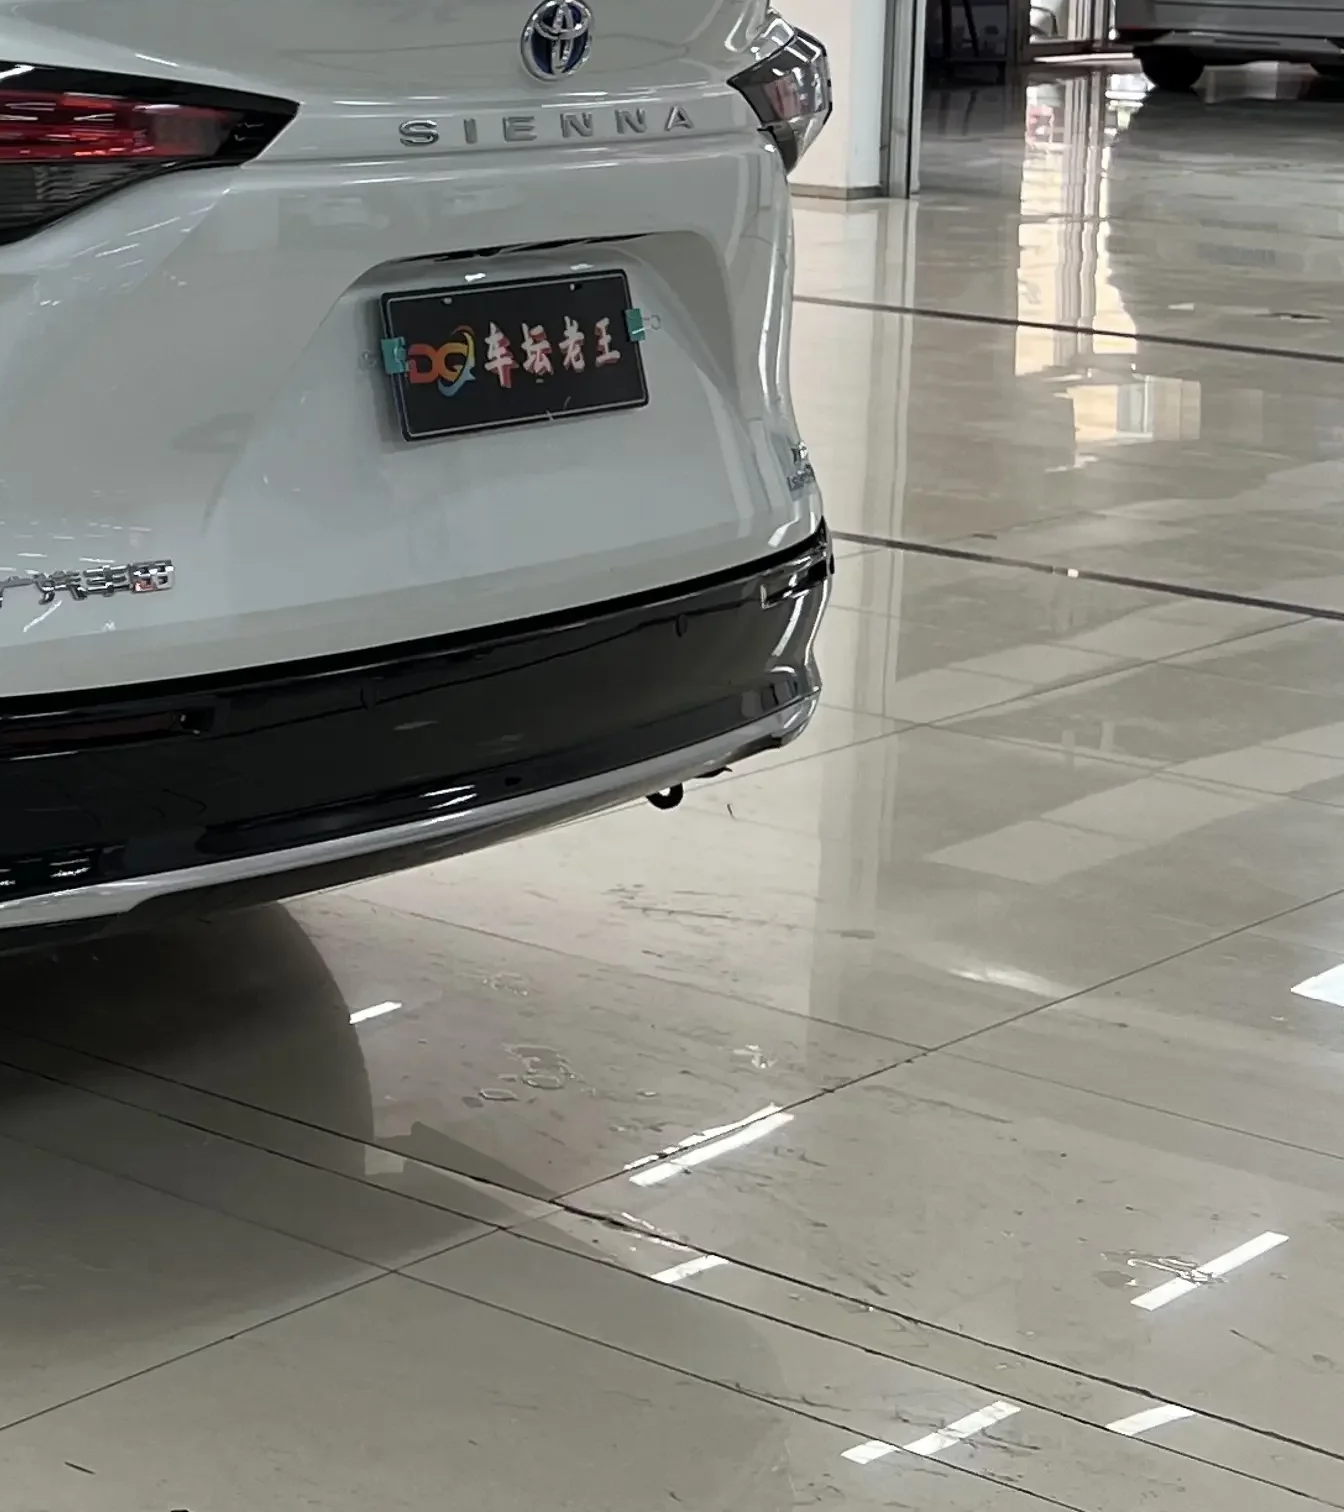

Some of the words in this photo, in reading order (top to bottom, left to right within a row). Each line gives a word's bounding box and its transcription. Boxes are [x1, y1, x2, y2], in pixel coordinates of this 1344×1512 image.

[398, 105, 695, 147] SIENNA
[484, 315, 622, 389] 车坛老王
